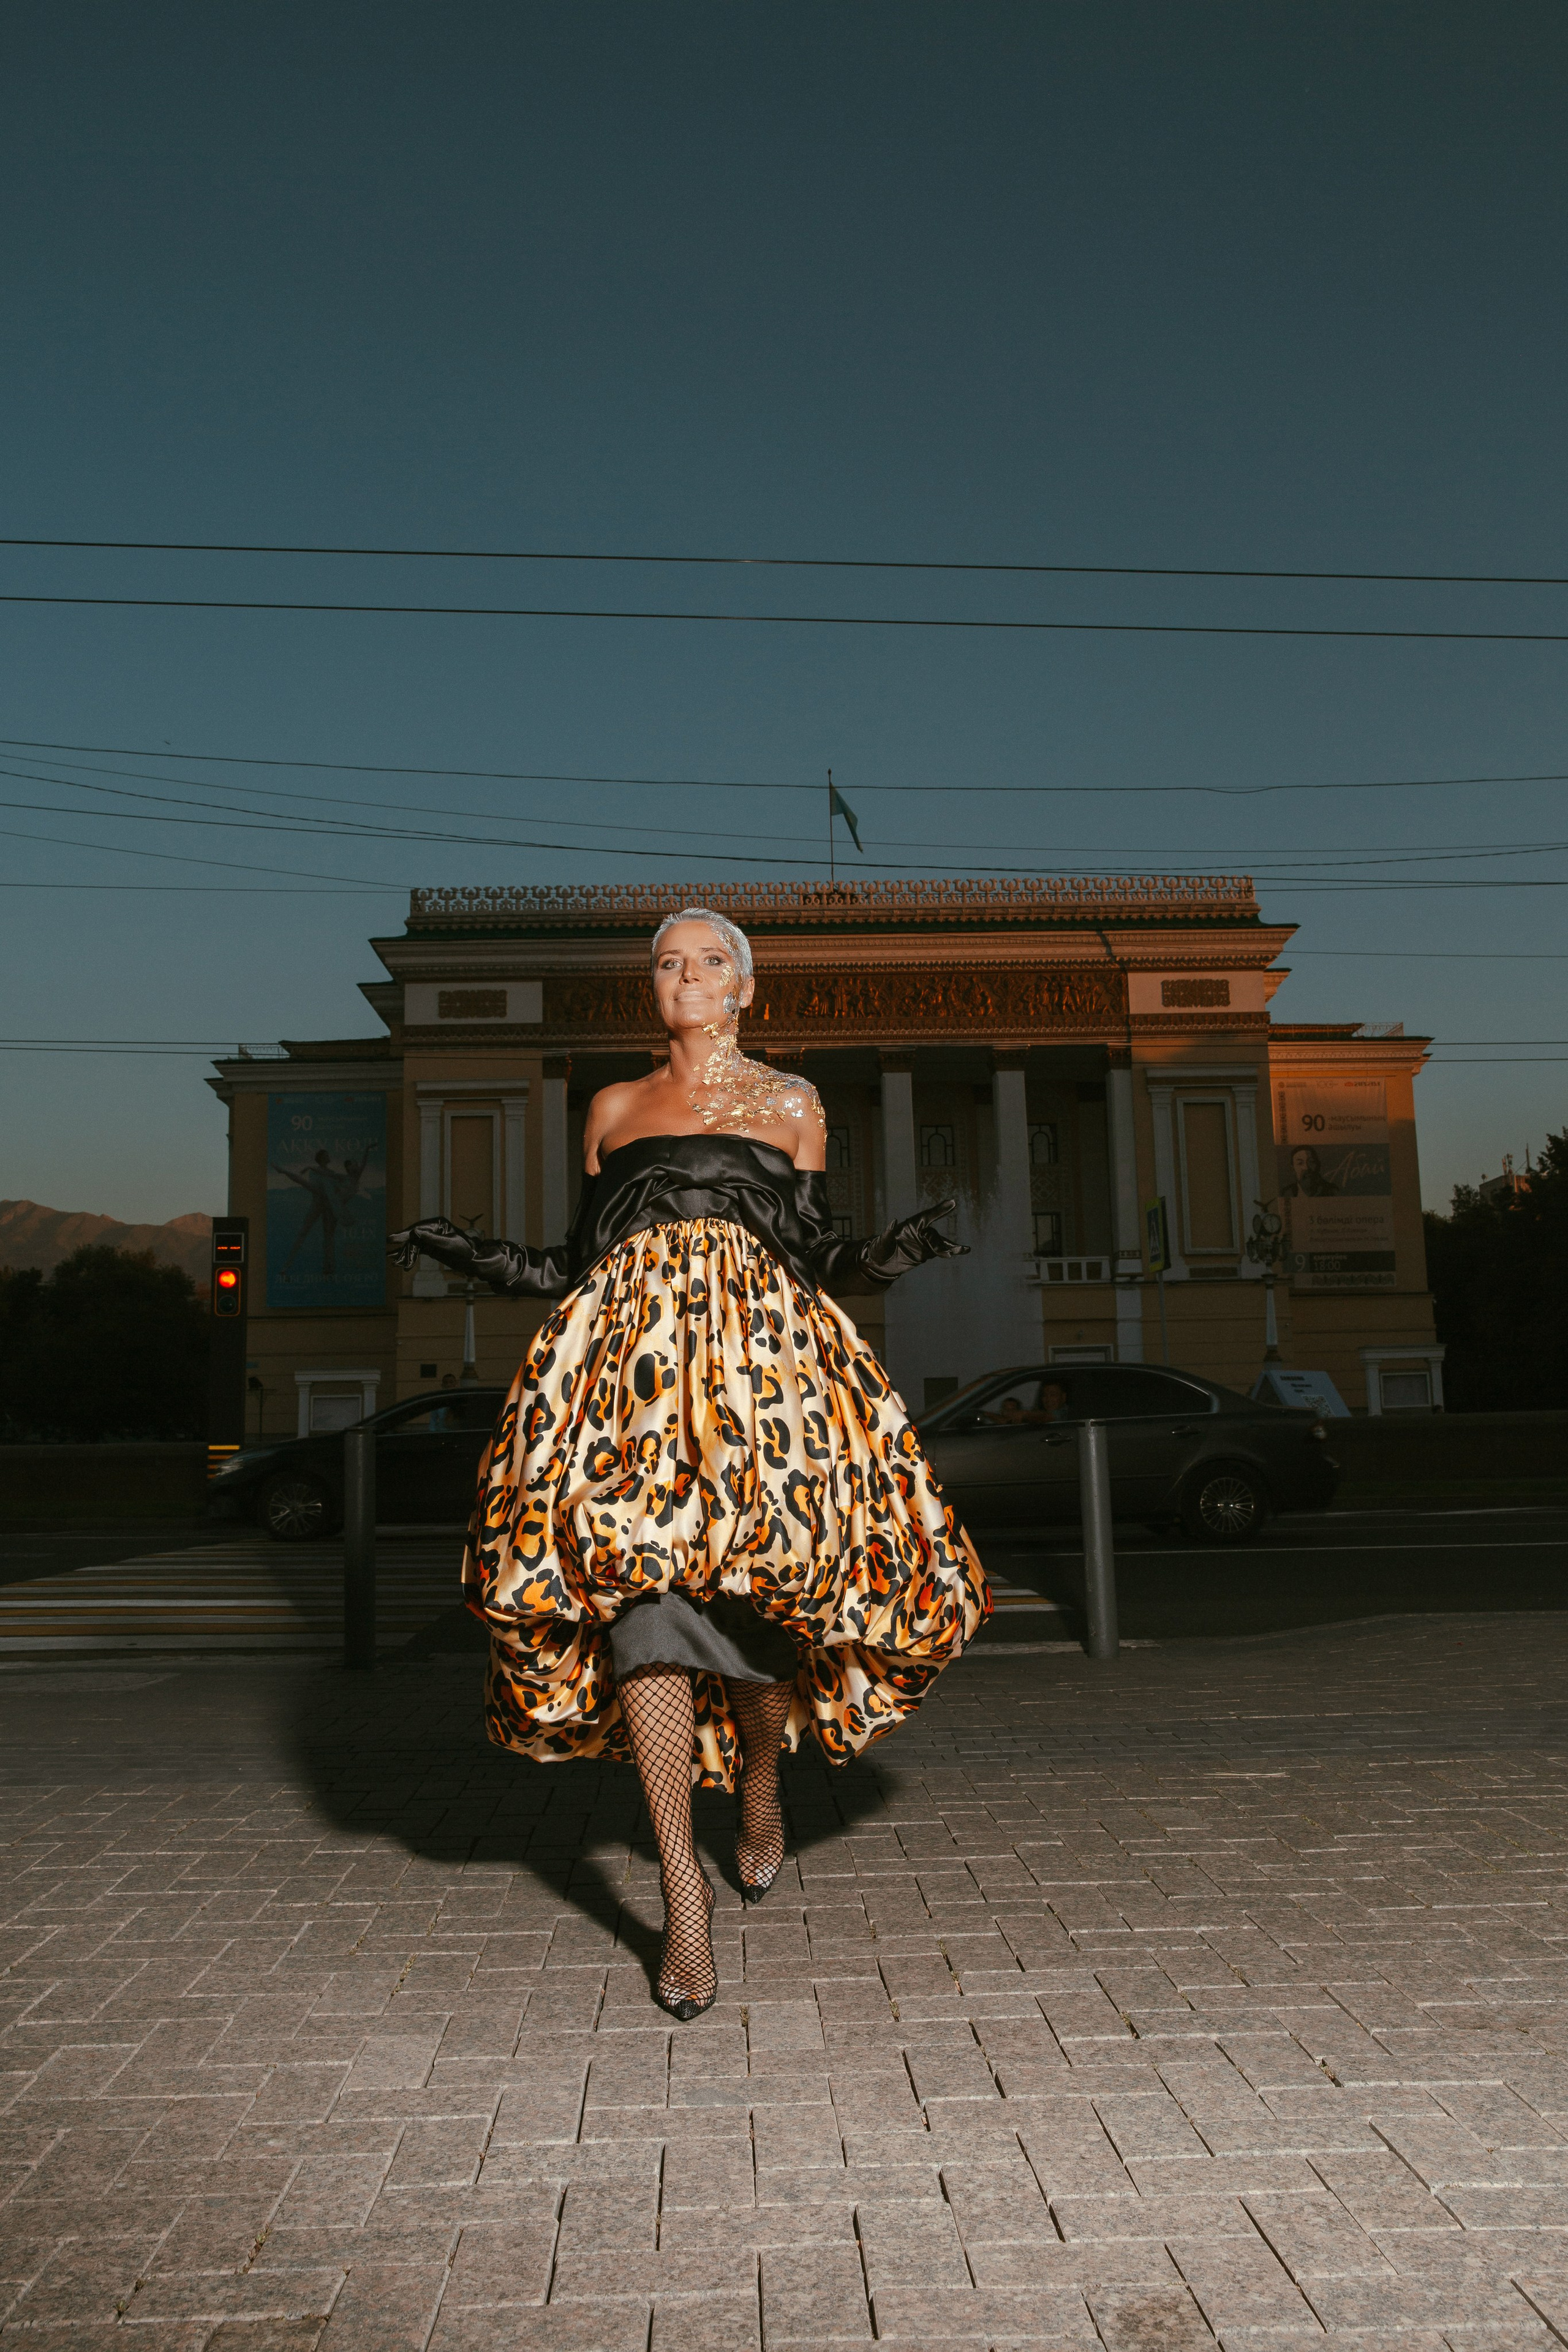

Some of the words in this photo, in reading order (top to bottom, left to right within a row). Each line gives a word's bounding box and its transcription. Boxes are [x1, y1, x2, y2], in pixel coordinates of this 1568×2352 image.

[291, 1115, 313, 1131] 90
[1302, 1114, 1325, 1132] 90
[1323, 1151, 1386, 1188] Абай
[1309, 1215, 1314, 1224] 3
[1355, 1216, 1384, 1224] опера
[1295, 1254, 1306, 1272] 9
